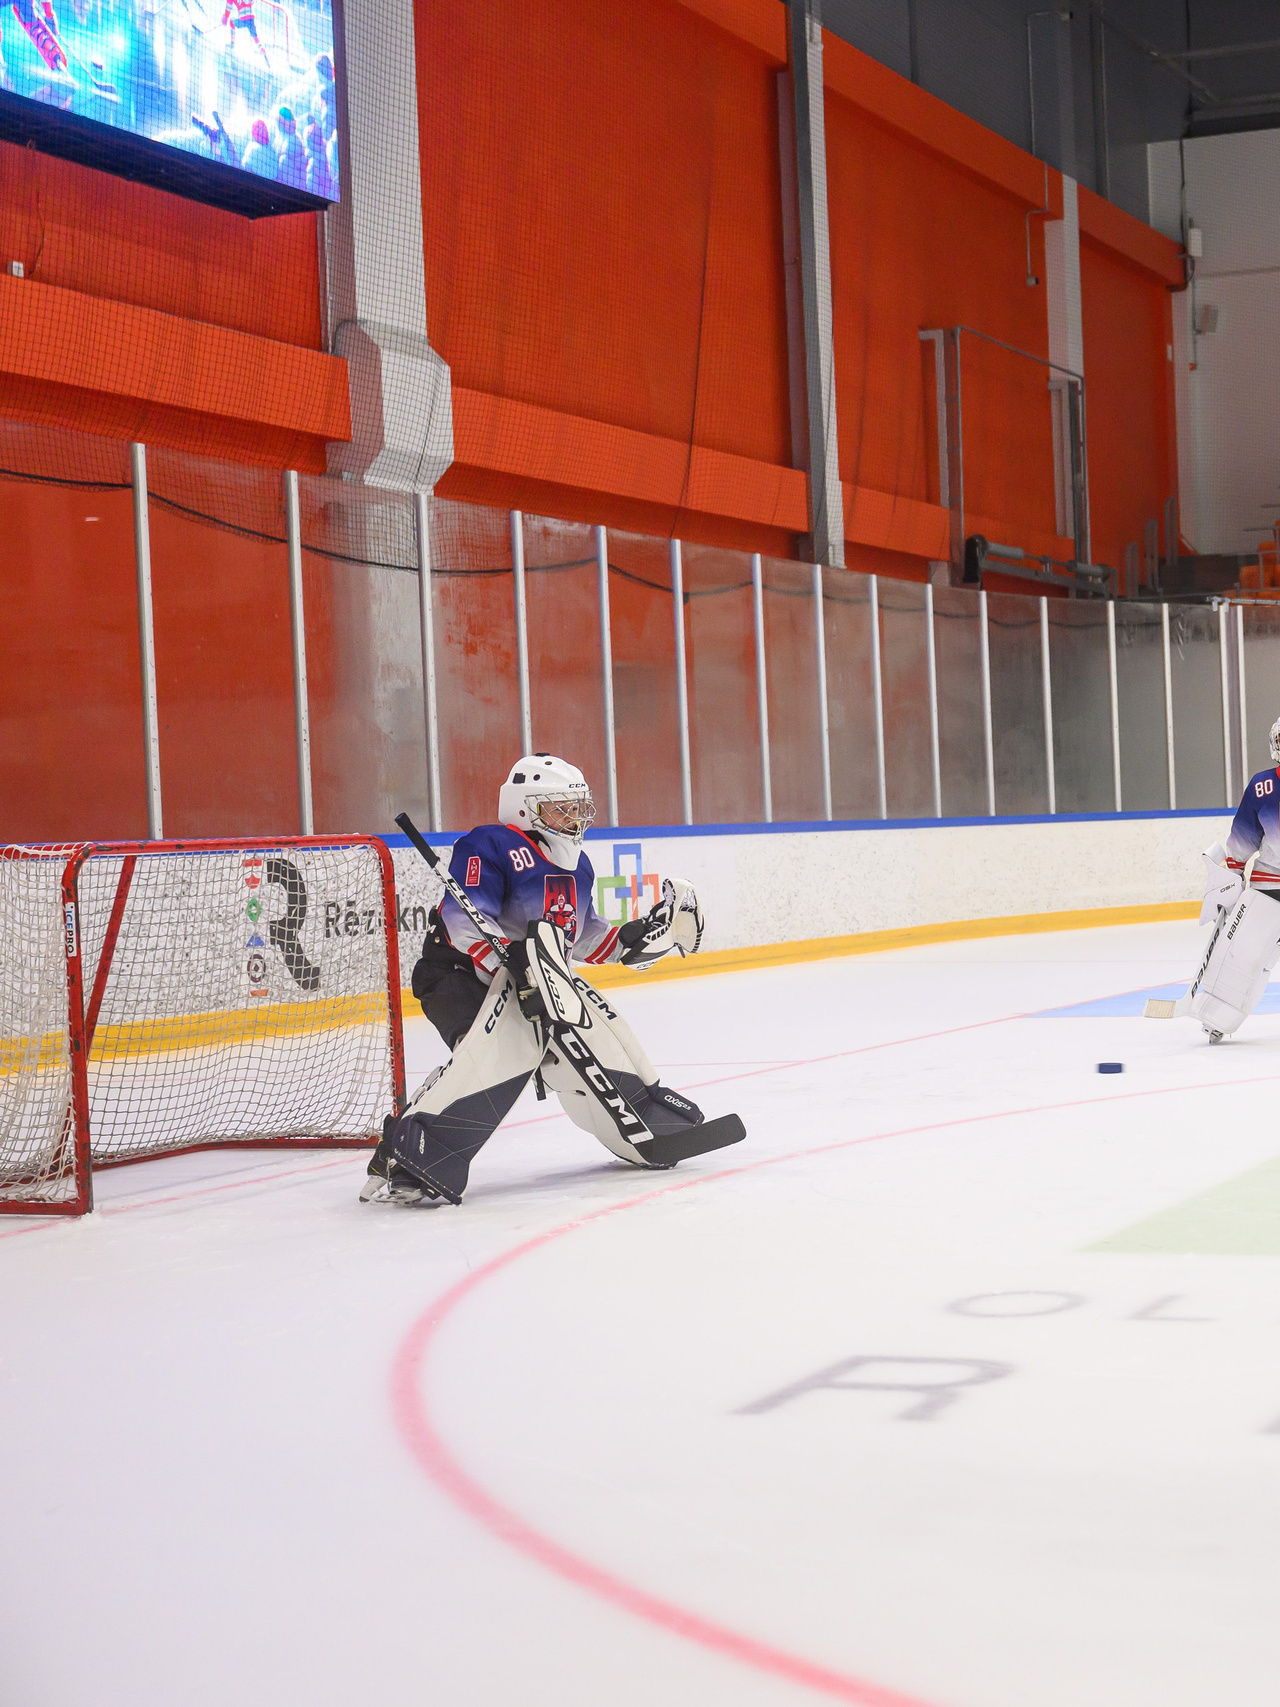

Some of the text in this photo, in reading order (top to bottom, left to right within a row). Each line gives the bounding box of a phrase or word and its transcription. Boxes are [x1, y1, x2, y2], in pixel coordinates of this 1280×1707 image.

[1254, 779, 1274, 799] 80
[508, 846, 536, 873] 80
[447, 878, 487, 925] CCM
[1226, 903, 1247, 941] BAUER
[66, 910, 75, 954] ICEPRO
[1191, 927, 1221, 1000] BAUER
[484, 979, 515, 1035] CCM
[543, 967, 566, 1015] CCM
[573, 977, 618, 1021] CCM
[560, 1028, 639, 1127] CCM
